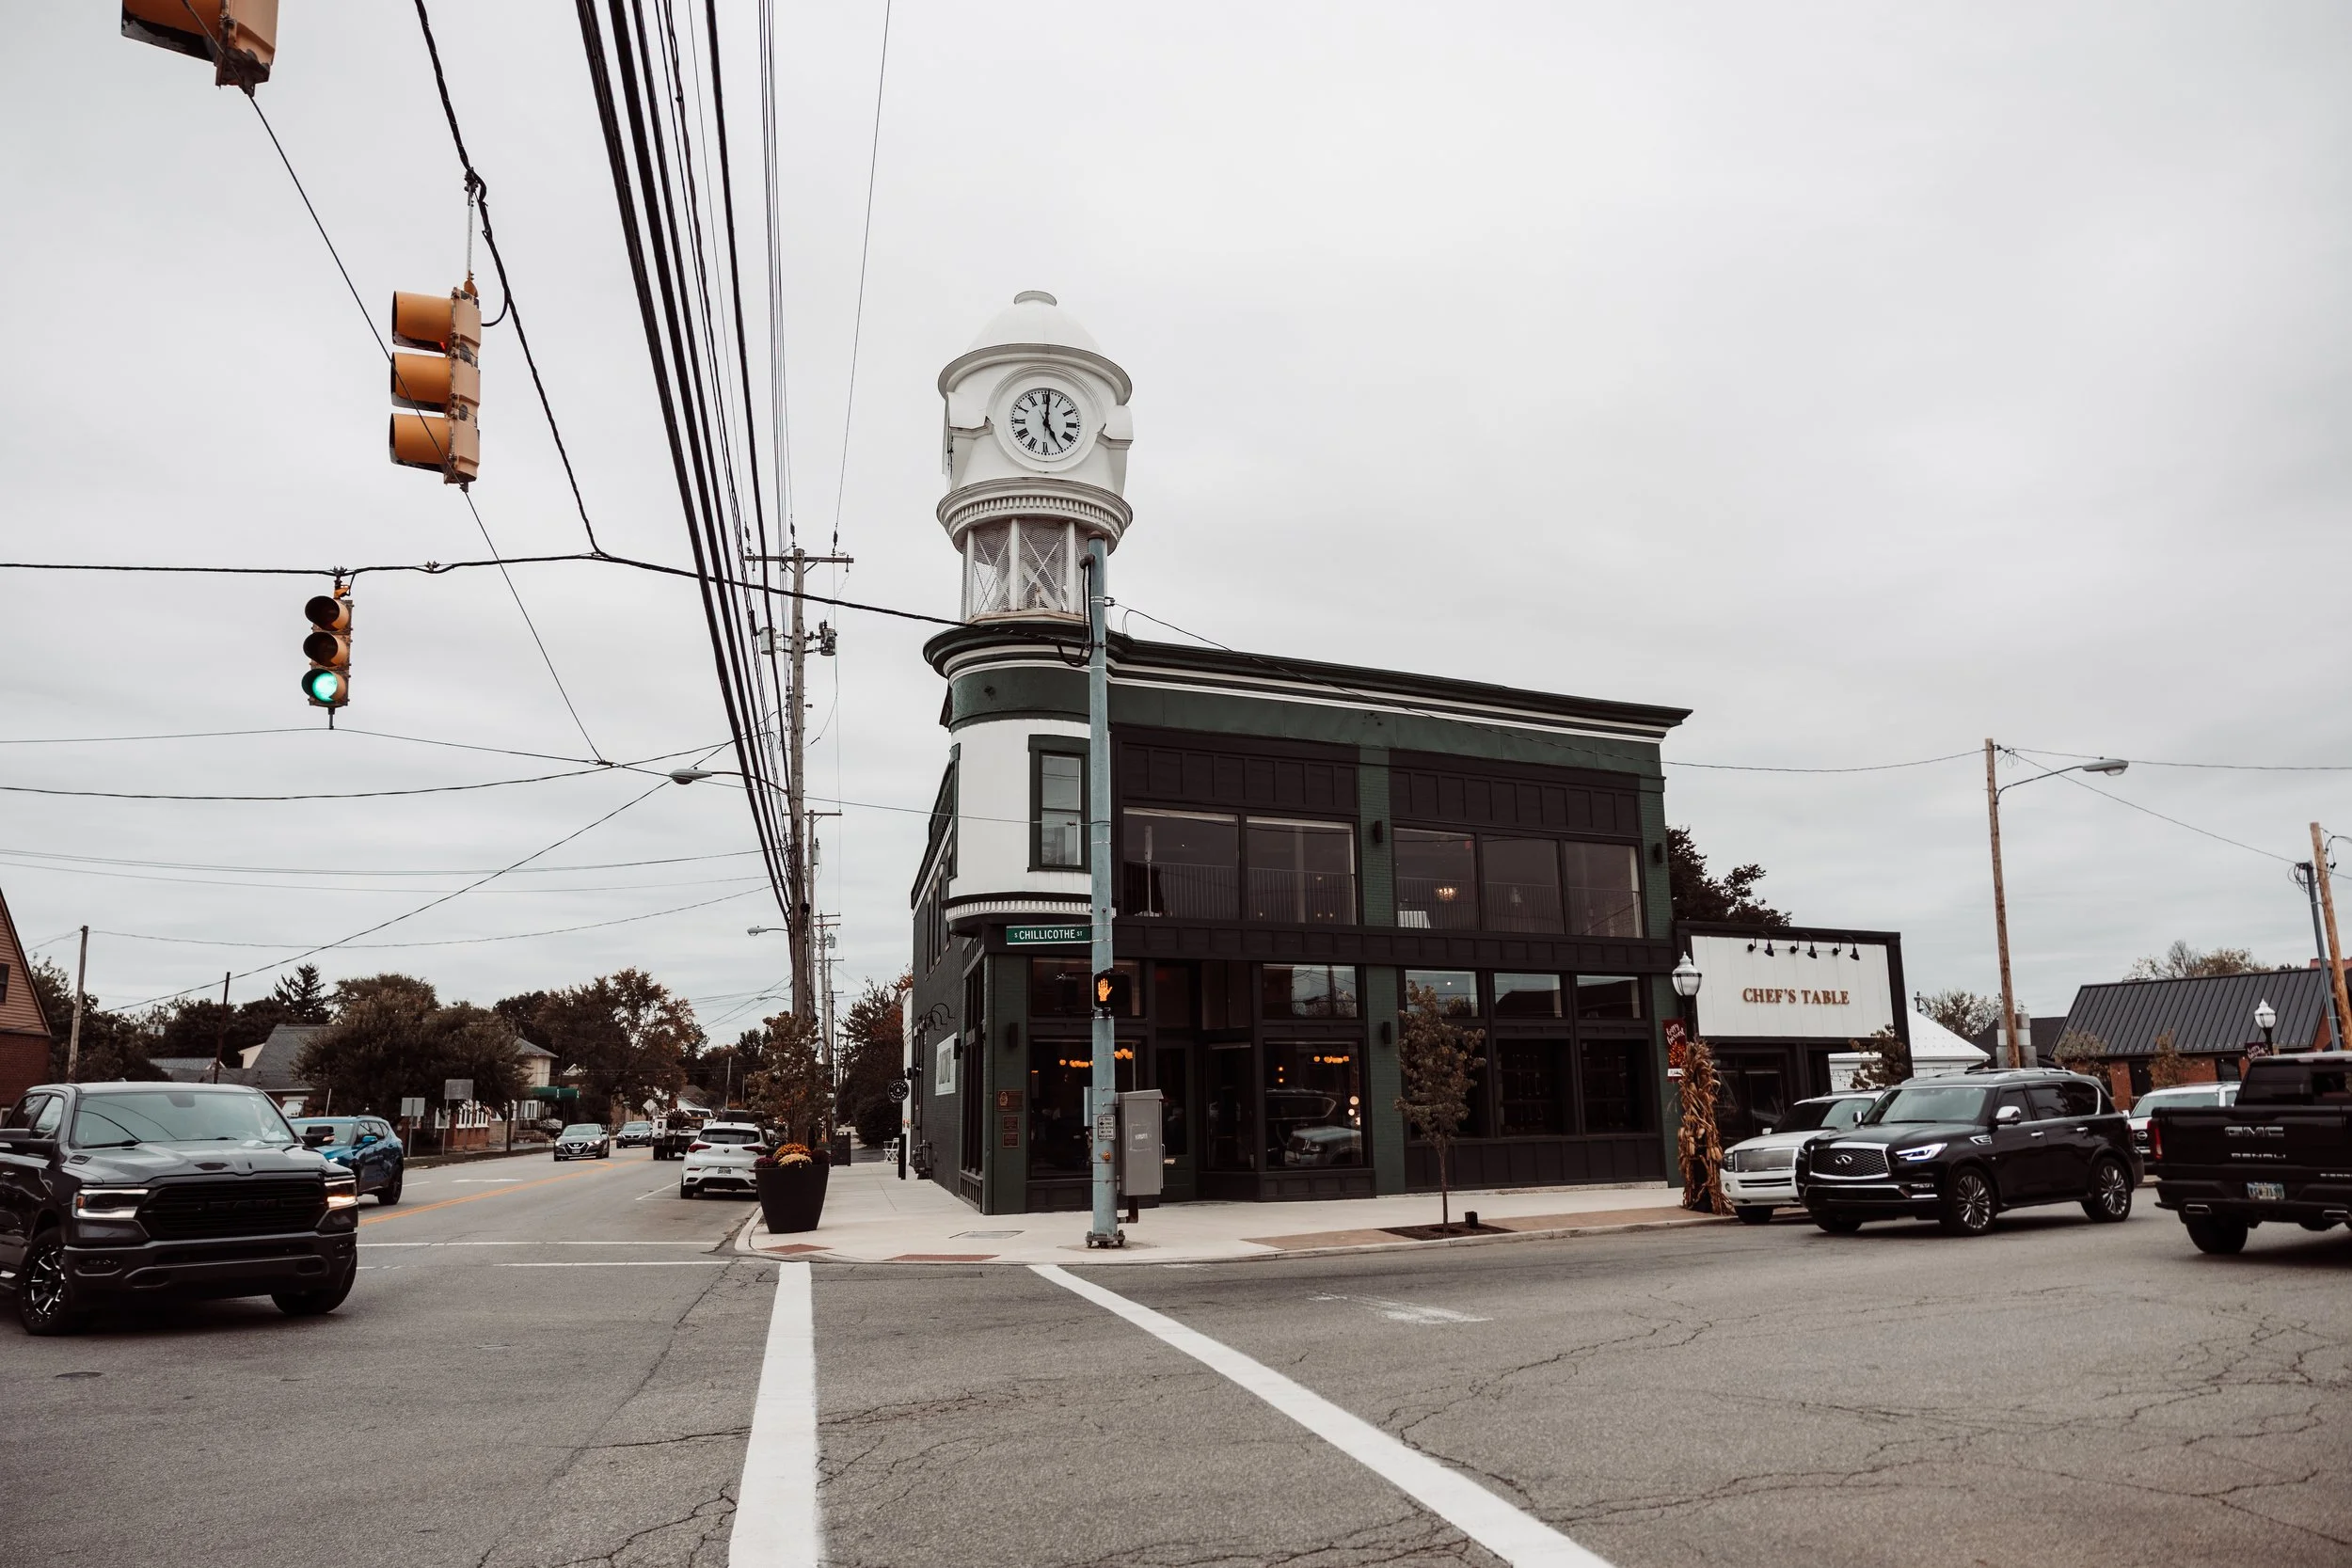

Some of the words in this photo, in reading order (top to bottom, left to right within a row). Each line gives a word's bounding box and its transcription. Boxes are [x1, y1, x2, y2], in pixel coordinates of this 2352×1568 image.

[1019, 929, 1075, 940] CHILLICOTHE
[1742, 988, 1797, 1004] CHEF'S
[1801, 990, 1850, 1005] TABLE
[2224, 1126, 2284, 1137] GMC
